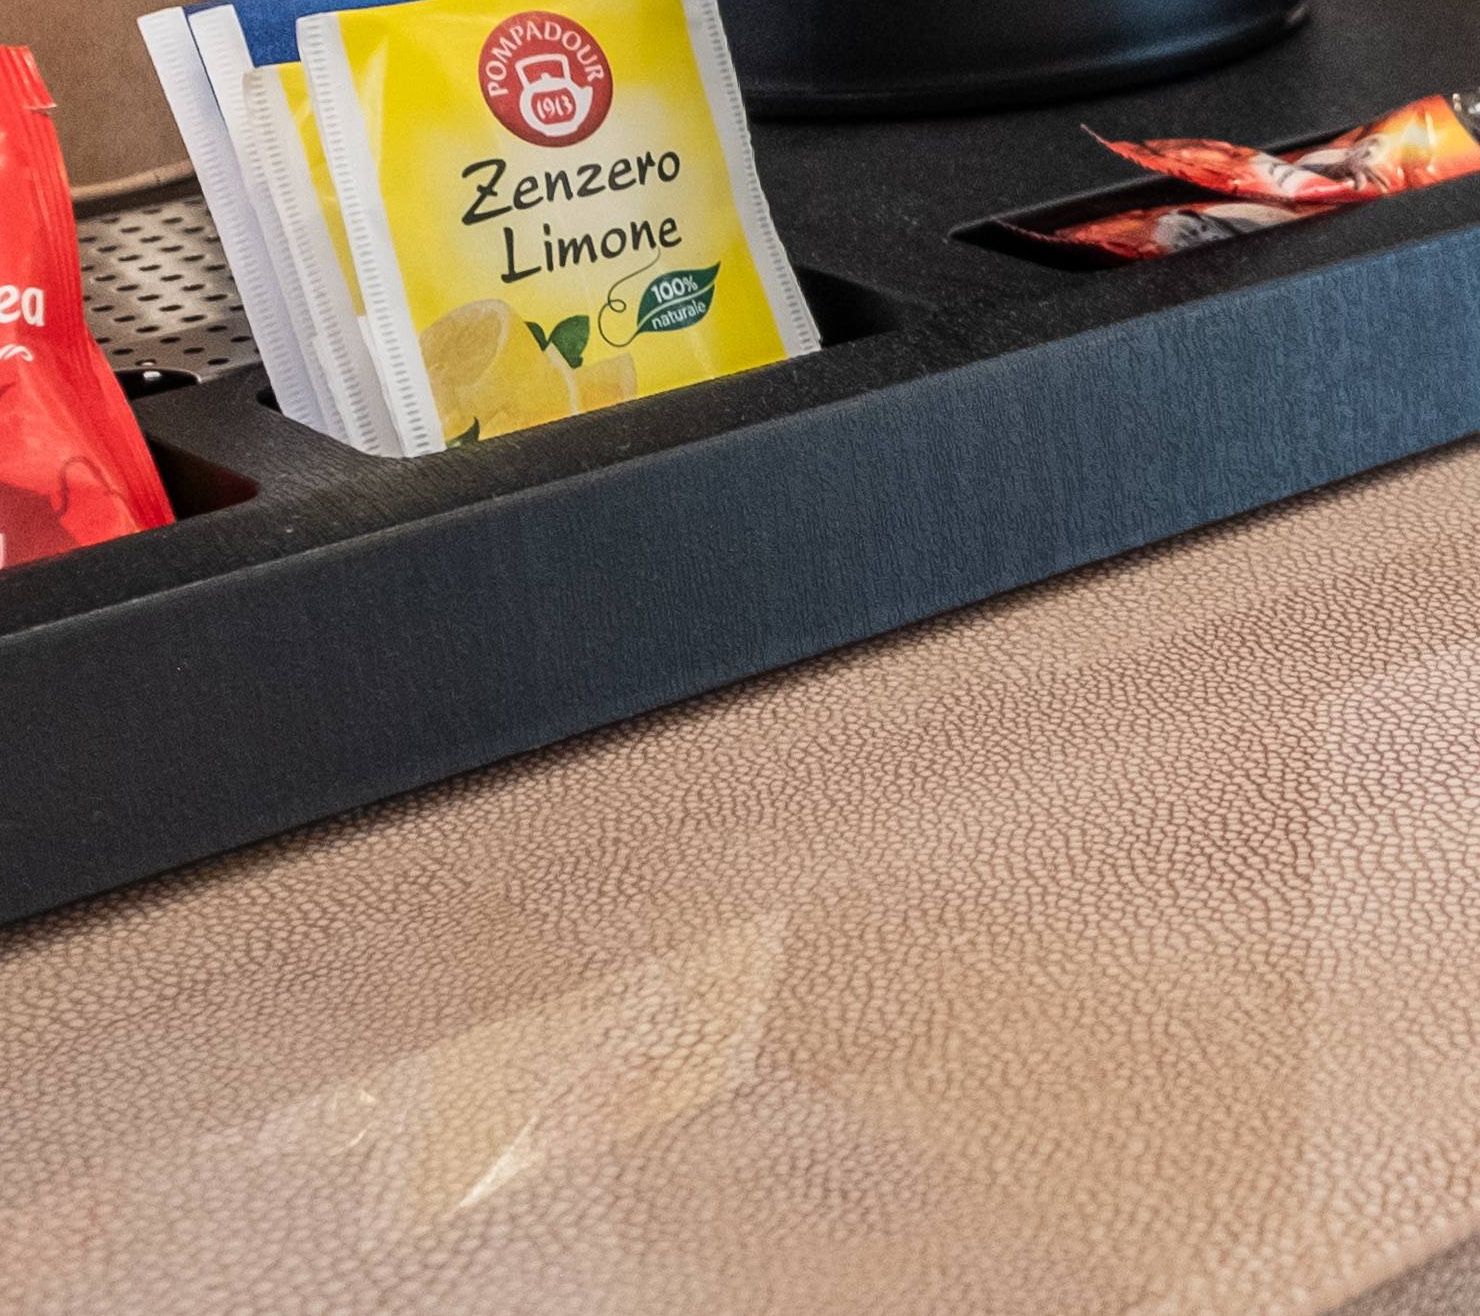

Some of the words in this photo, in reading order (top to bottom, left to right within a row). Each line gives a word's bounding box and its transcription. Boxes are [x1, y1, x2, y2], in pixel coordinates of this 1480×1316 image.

[485, 20, 605, 98] POMPADOUR
[536, 95, 574, 120] 1913
[461, 151, 681, 225] Zenzero
[501, 217, 682, 283] Limone
[651, 274, 698, 303] 100%
[652, 299, 706, 329] naturale
